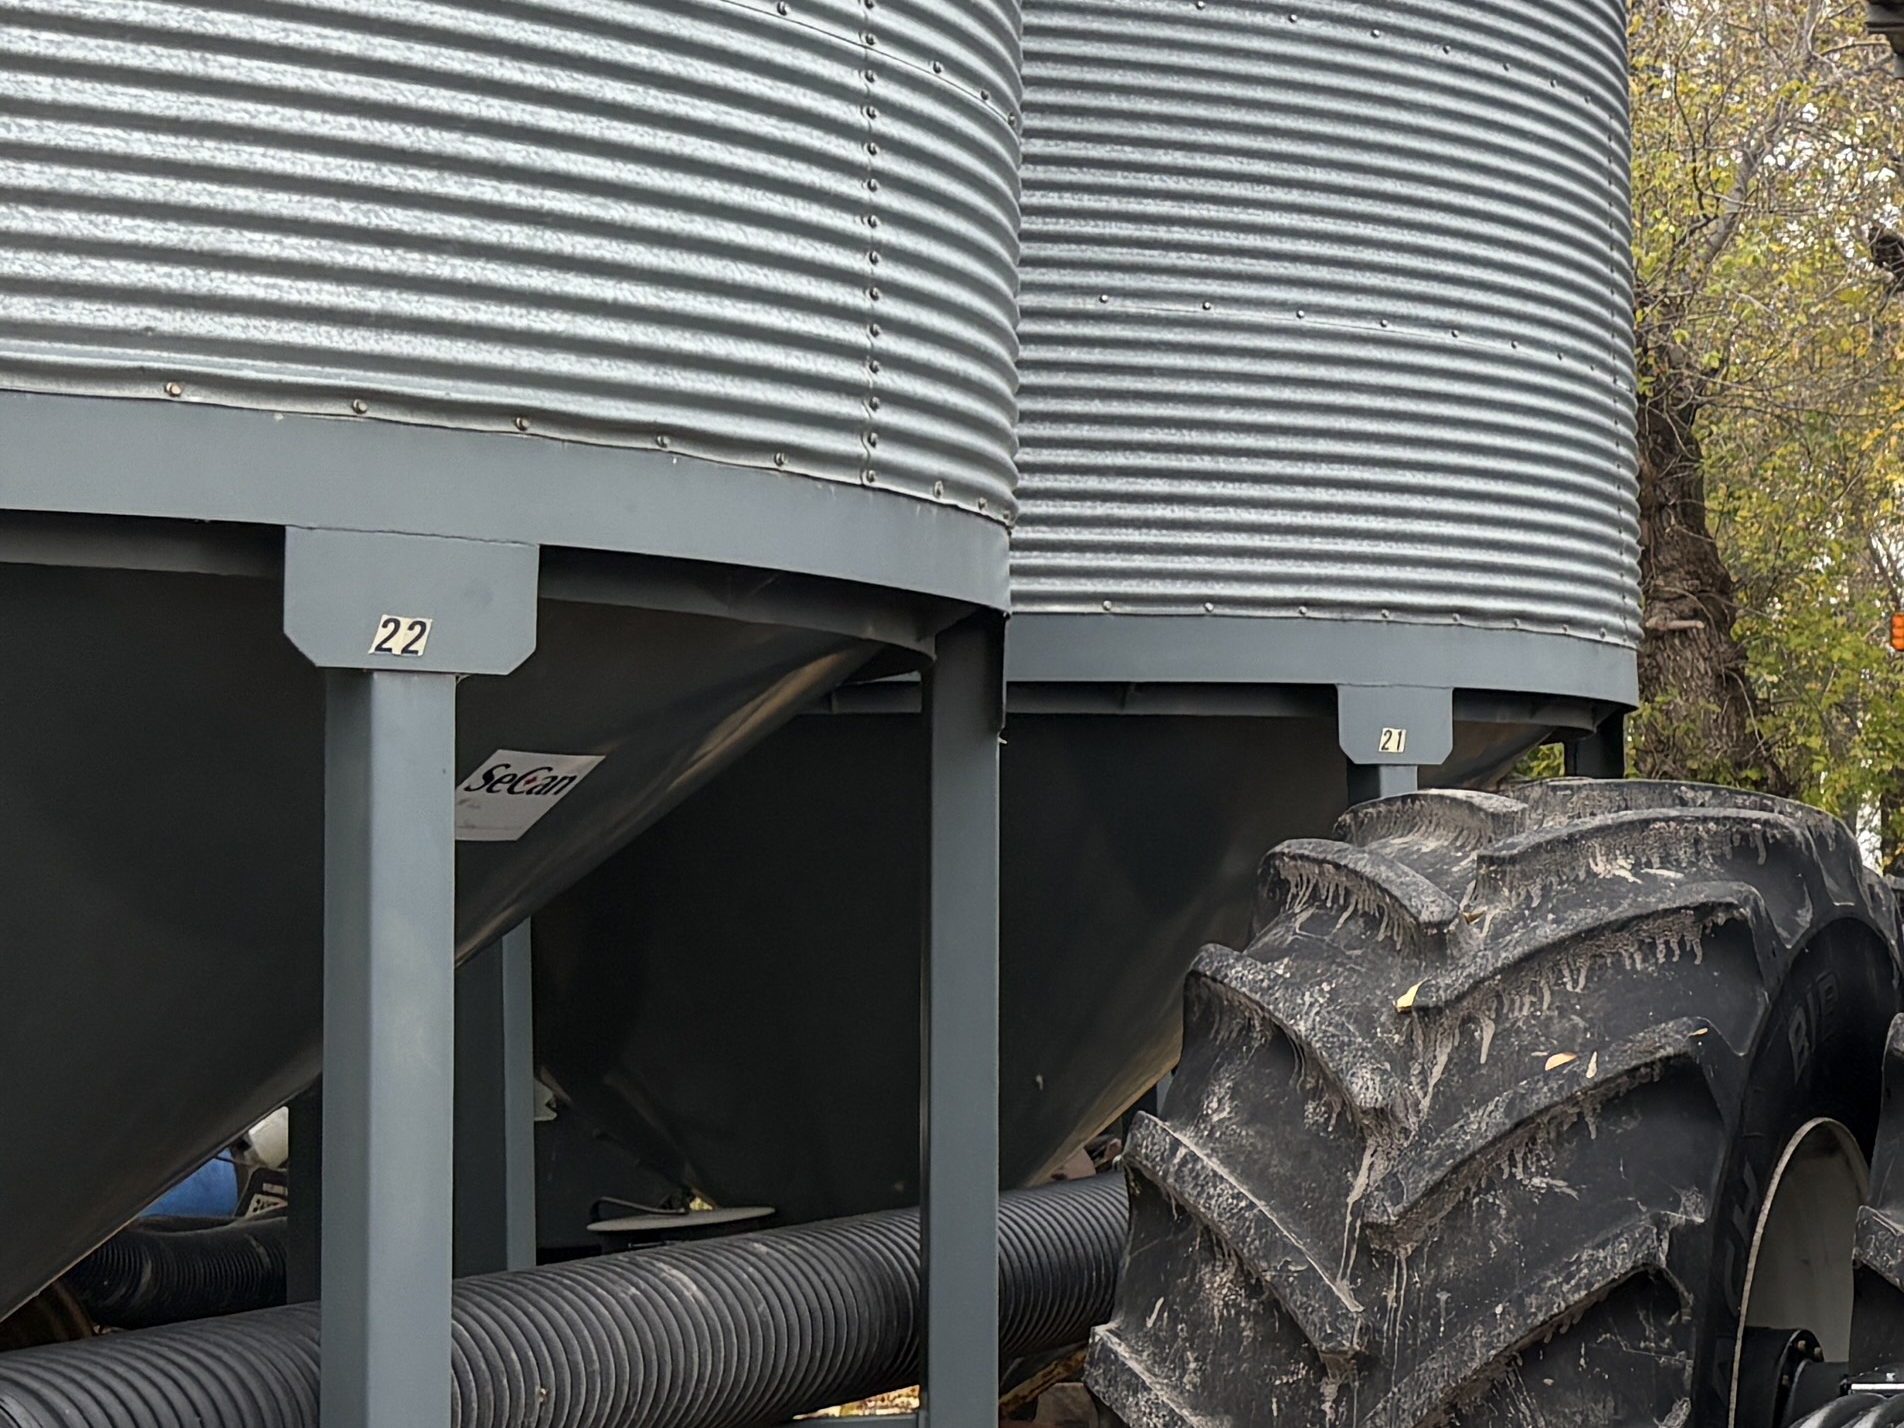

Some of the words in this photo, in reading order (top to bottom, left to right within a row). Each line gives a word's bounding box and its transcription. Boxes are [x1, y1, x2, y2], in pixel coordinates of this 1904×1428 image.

[374, 617, 427, 655] 22
[1380, 729, 1403, 751] 21
[463, 762, 578, 796] SeCan
